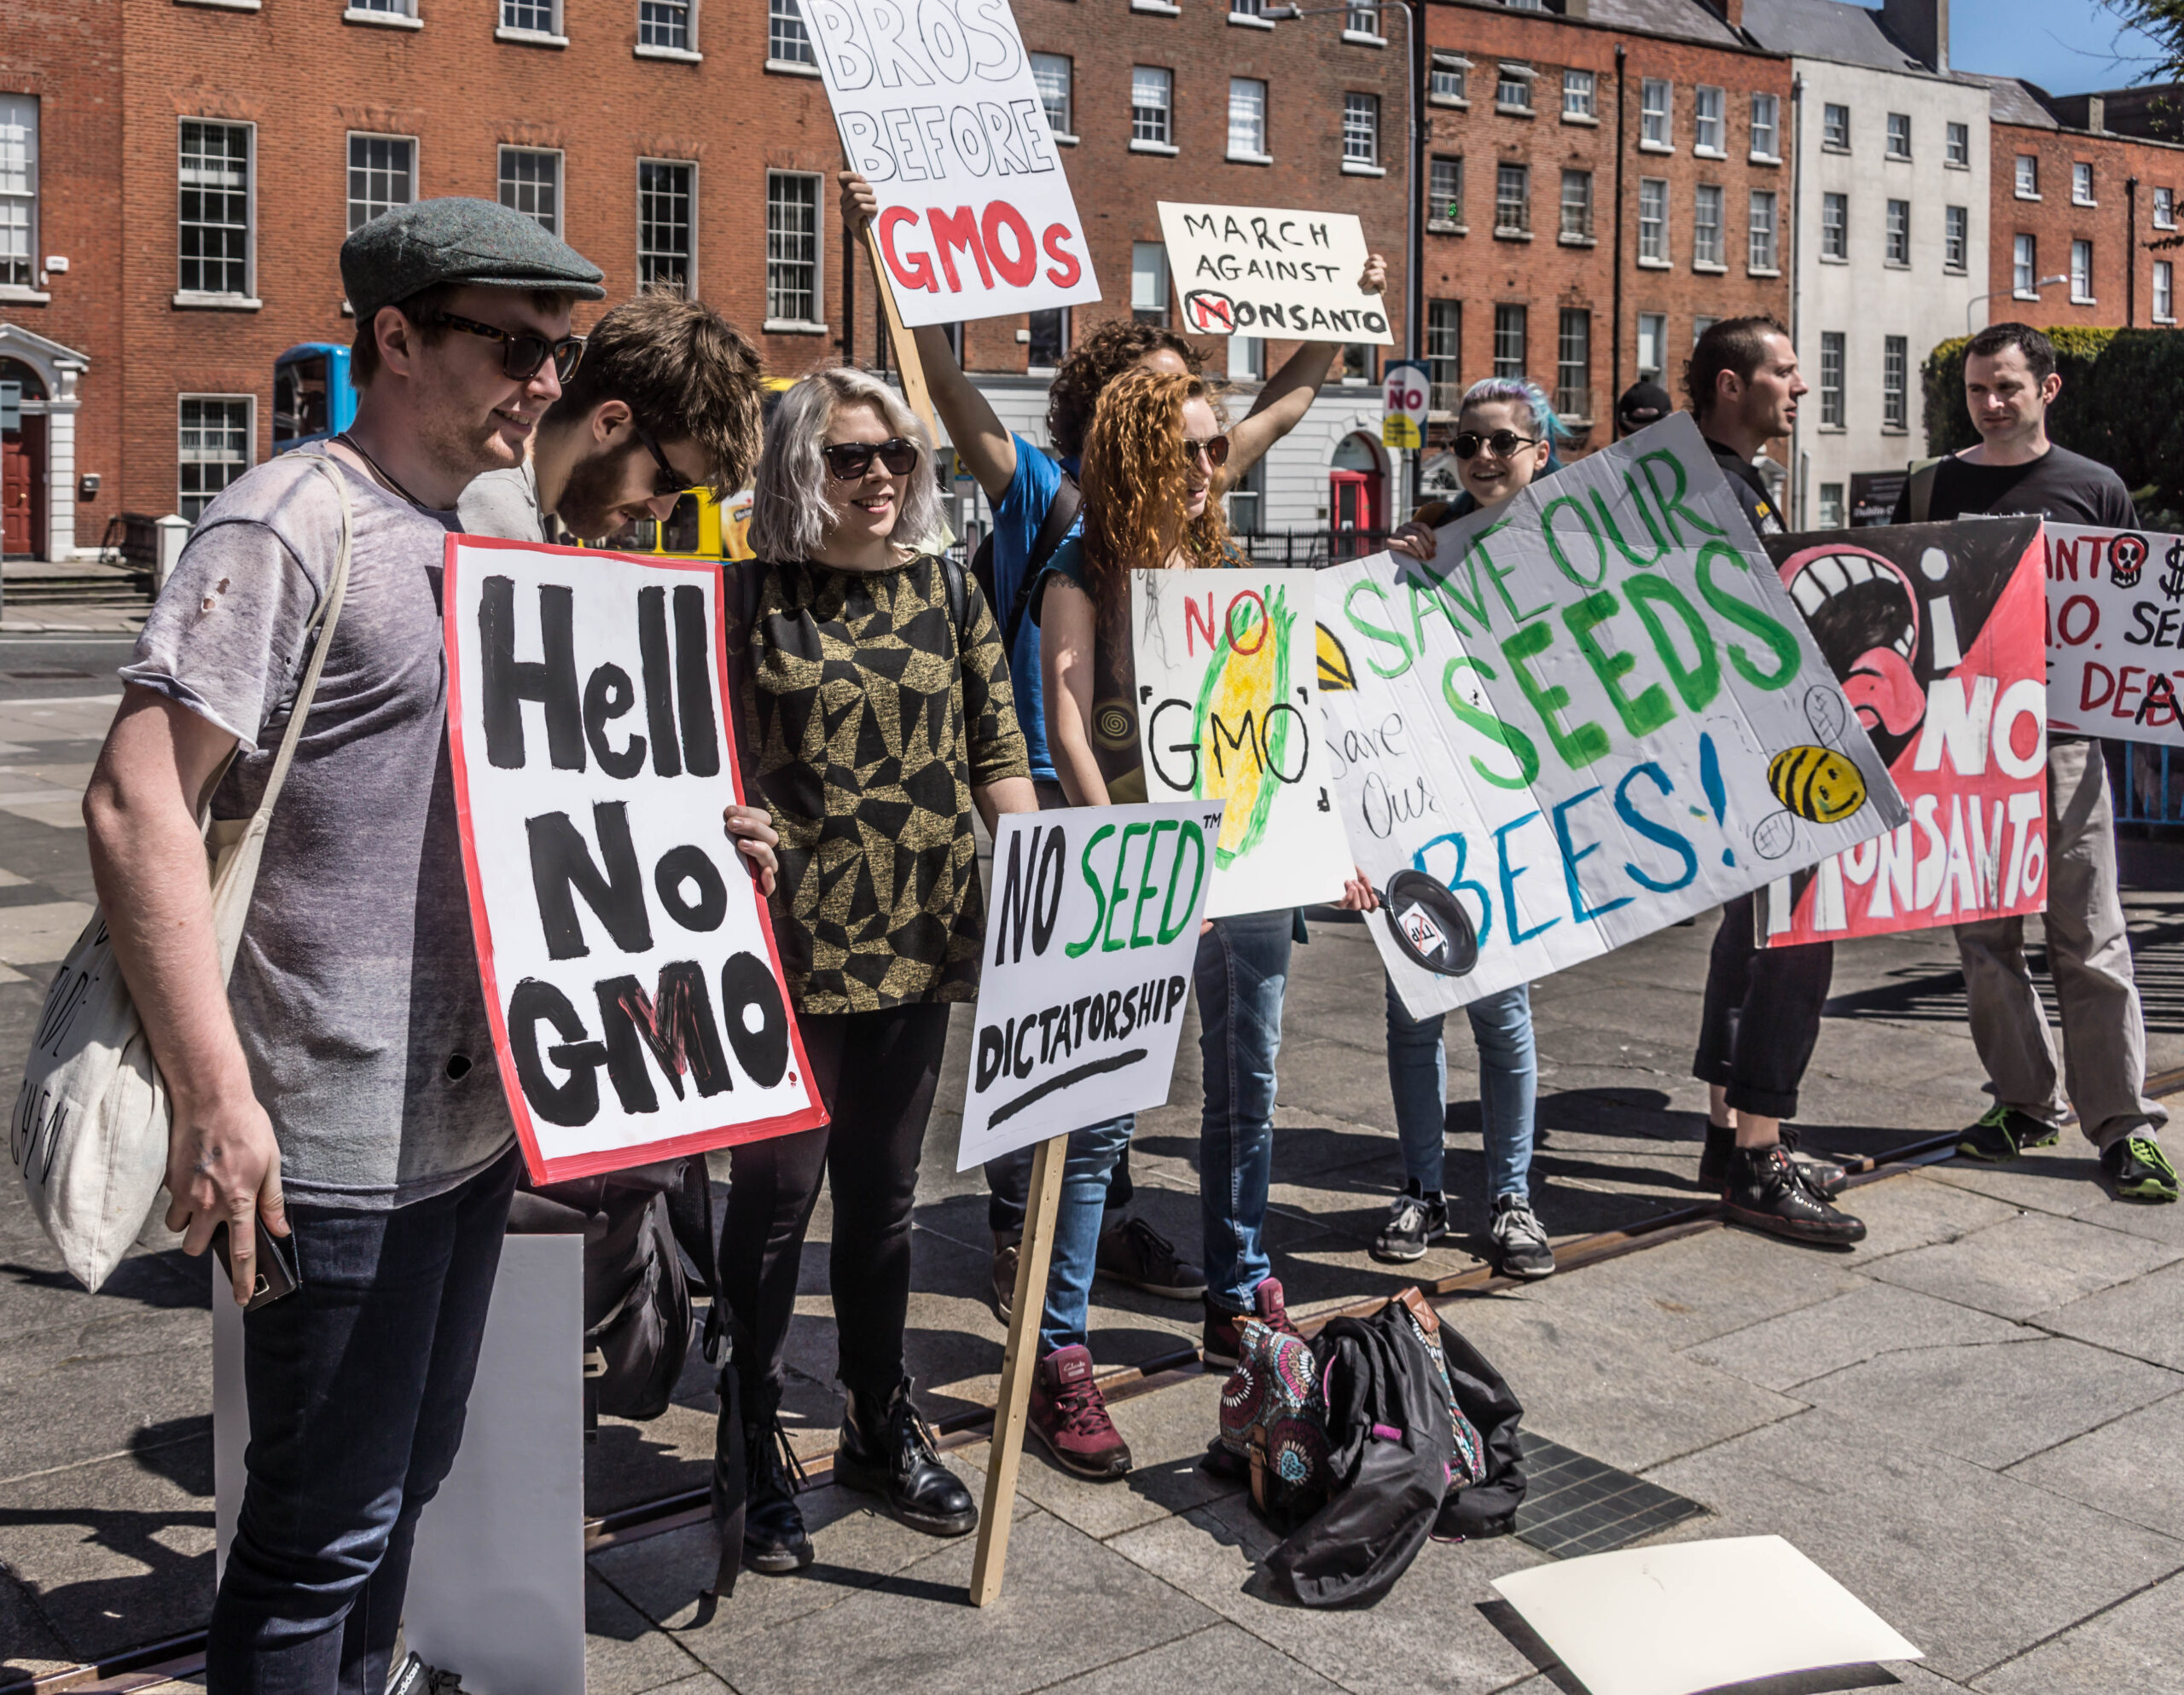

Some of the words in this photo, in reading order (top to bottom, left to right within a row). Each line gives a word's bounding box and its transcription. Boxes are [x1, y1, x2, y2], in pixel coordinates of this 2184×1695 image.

[808, 0, 1021, 91] BROS
[839, 99, 1055, 183] BEFORE
[879, 199, 1082, 293] GMOs
[1183, 213, 1330, 253] MARCH
[1195, 254, 1341, 283] AGAINST
[1185, 291, 1387, 334] MONSANTO
[1389, 388, 1423, 411] NO
[1343, 516, 1556, 680] SAVE
[1542, 448, 1729, 589] OUR
[1184, 589, 1269, 658] NO
[1442, 539, 1802, 790] SEEDS
[479, 575, 720, 780] Hell
[1914, 675, 2048, 780] NO
[1362, 771, 1442, 839] Our
[1410, 731, 1736, 955] BEES!
[525, 800, 728, 961] No
[995, 824, 1066, 967] NO
[974, 974, 1186, 1094] DICTATORSHIP
